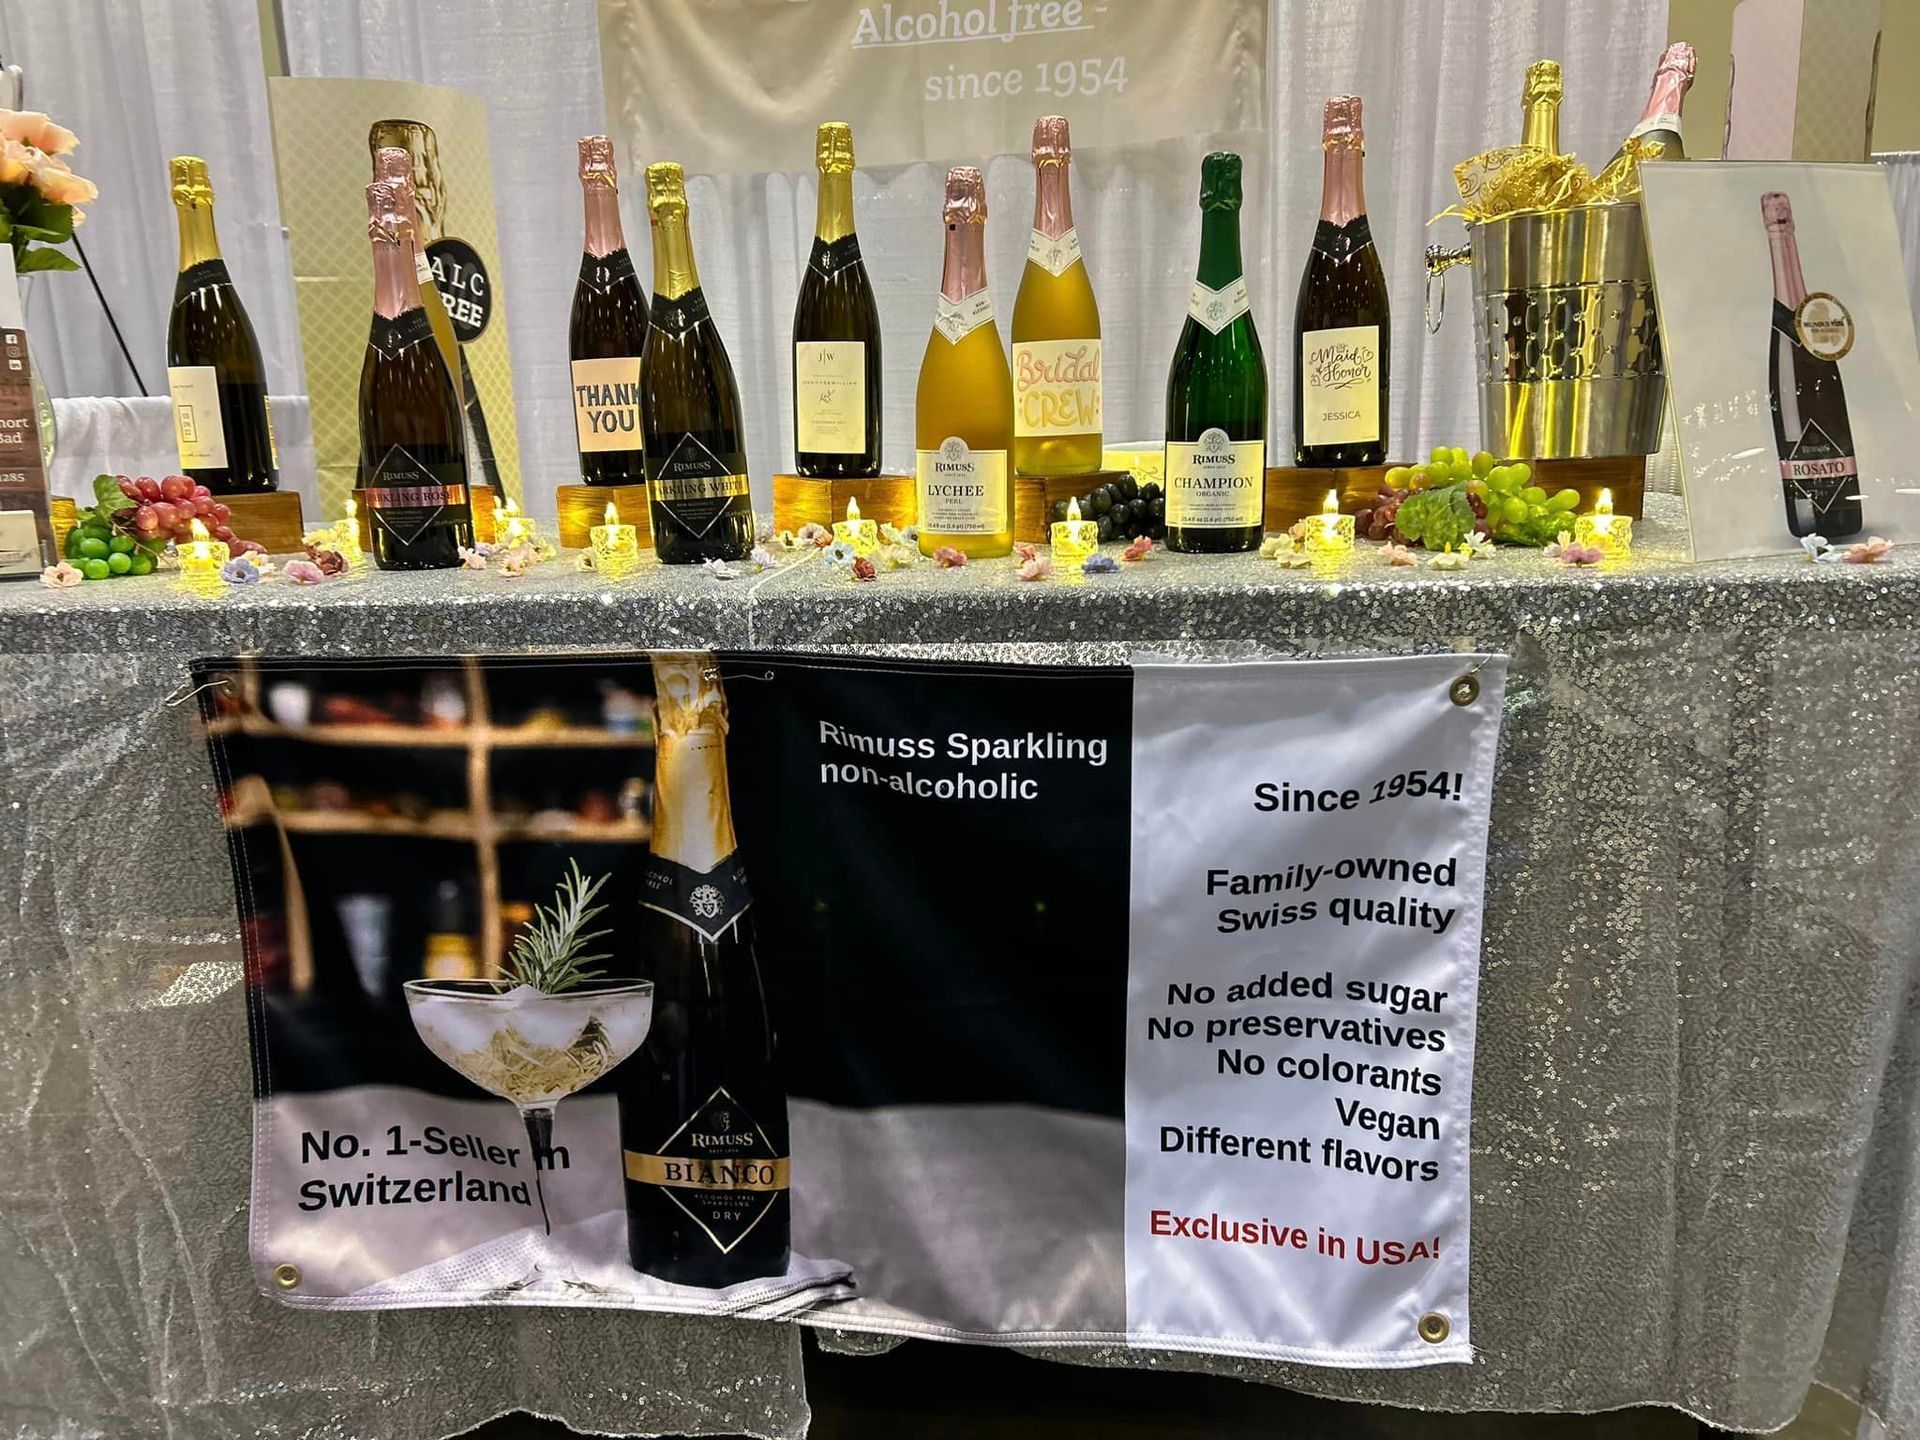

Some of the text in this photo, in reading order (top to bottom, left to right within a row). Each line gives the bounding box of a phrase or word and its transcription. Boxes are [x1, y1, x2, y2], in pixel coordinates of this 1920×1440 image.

[852, 0, 998, 45] Alcohol
[1001, 0, 1083, 42] free
[924, 56, 1128, 101] since 1954
[431, 255, 485, 297] ALC
[439, 290, 484, 328] REE
[1016, 345, 1100, 392] Bridal
[1310, 345, 1362, 366] Maid
[1322, 361, 1372, 383] Honor
[586, 408, 635, 434] YOU
[1023, 387, 1095, 429] CREW
[1322, 410, 1361, 422] JESSICA
[382, 470, 420, 481] RIMUSS
[673, 461, 711, 473] RIMUSS
[935, 462, 975, 473] RIMUSS
[1193, 453, 1236, 465] RIMUSS
[1793, 461, 1845, 477] ROSATO
[928, 484, 985, 497] LYCHEE
[1174, 476, 1254, 490] CHAMPION
[1196, 490, 1230, 498] ORGANIC
[819, 720, 1108, 766] Rimuss Sparkling
[820, 762, 1039, 800] non-alcoholic
[1253, 770, 1463, 813] Since 1954!
[1206, 857, 1457, 896] Family-owned
[1216, 896, 1456, 935] Swiss quality
[1167, 970, 1448, 1016] No added sugar
[1148, 1012, 1446, 1052] No preservatives
[1217, 1048, 1442, 1096] No colorants
[1335, 1097, 1440, 1142] Vegan
[301, 1130, 371, 1164] No.
[386, 1125, 521, 1168] 1-Seller
[691, 1131, 754, 1148] RIMUSS
[1160, 1125, 1439, 1182] Different flavors
[298, 1170, 533, 1212] Switzerland
[664, 1162, 776, 1186] BIANCO
[712, 1210, 742, 1220] DRY
[1149, 1210, 1441, 1266] Exclusive in USA!
